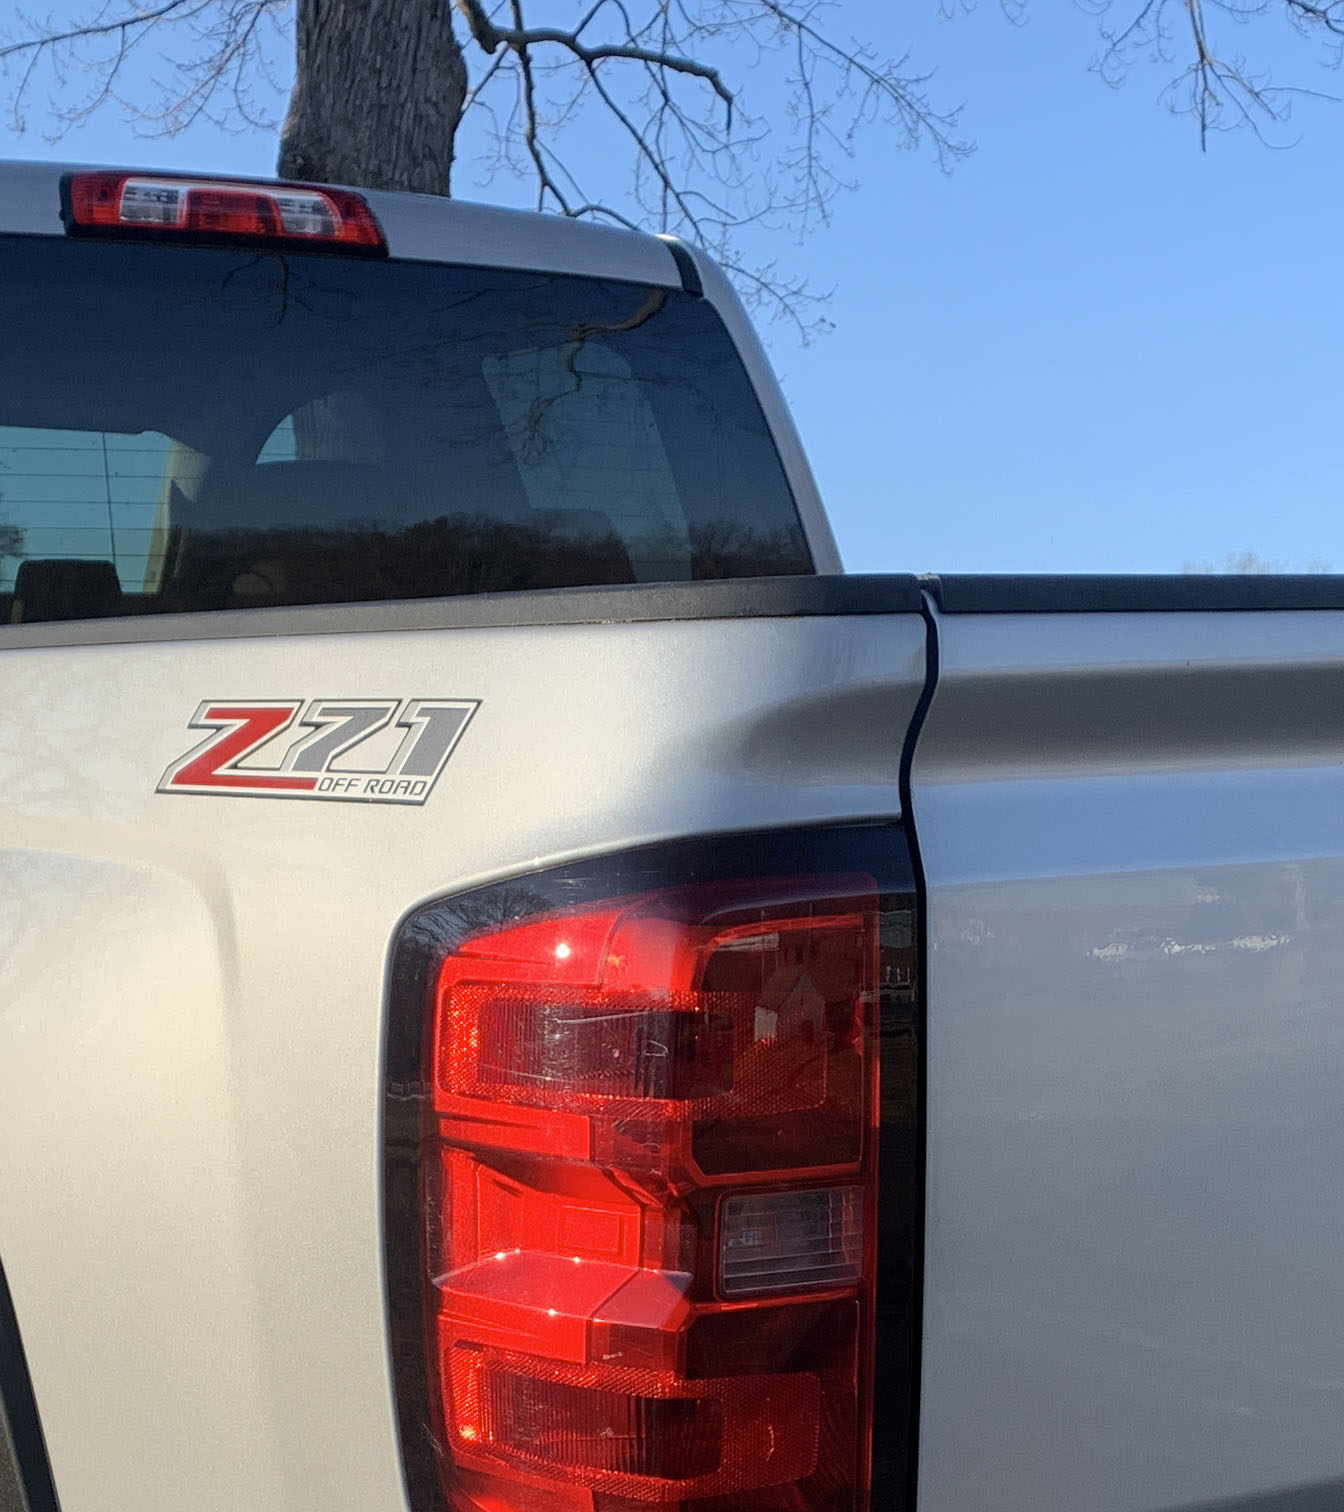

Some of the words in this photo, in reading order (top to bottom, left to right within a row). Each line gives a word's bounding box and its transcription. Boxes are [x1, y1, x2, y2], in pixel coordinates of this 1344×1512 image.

[156, 698, 483, 804] Z71
[317, 776, 361, 794] OFF
[362, 778, 428, 797] ROAD
